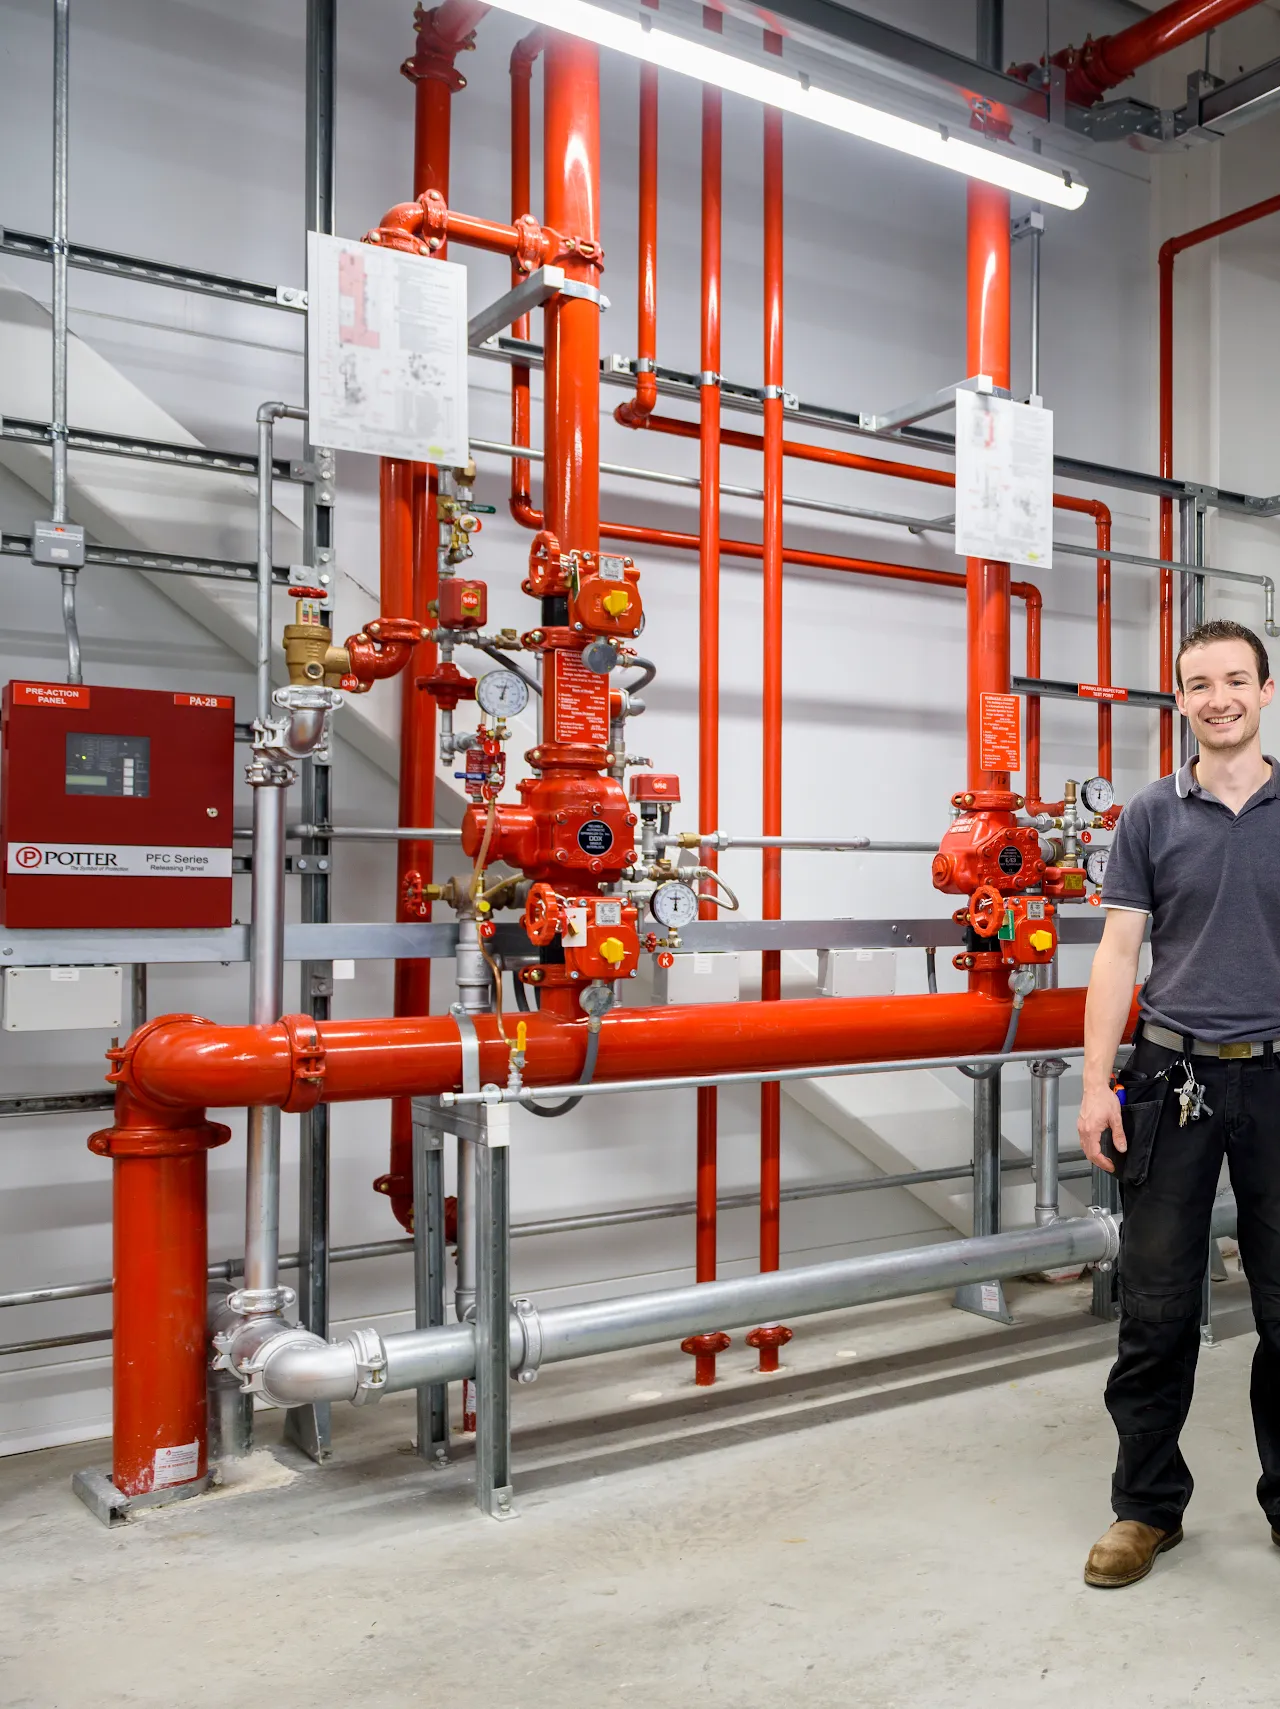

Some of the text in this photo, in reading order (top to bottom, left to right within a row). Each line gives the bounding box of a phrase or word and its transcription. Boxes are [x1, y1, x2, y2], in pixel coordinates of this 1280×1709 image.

[26, 688, 79, 698] PRE-ACTION
[38, 696, 66, 705] PANEL
[190, 696, 217, 707] PA-2B
[490, 746, 494, 754] J
[44, 852, 117, 866] POTTER
[146, 854, 208, 864] PFC Series
[662, 957, 669, 966] K
